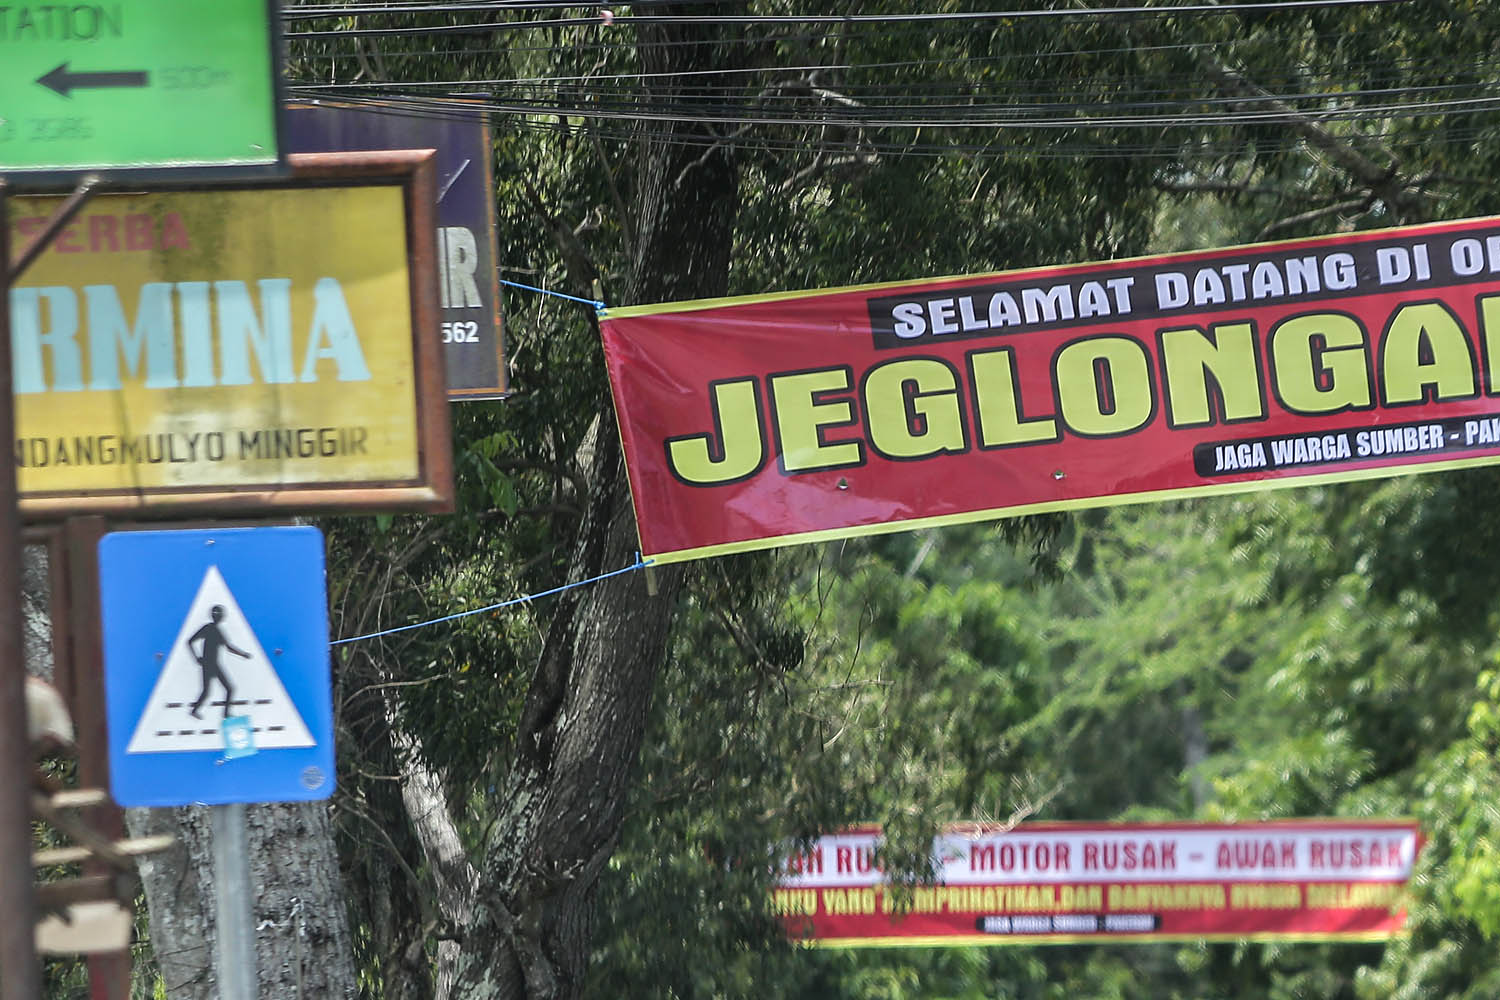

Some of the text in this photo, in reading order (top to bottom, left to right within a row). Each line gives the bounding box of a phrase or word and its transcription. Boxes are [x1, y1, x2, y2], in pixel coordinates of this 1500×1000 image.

[893, 276, 1135, 339] SELAMAT
[1155, 252, 1357, 310] DATANG
[1377, 245, 1430, 285] DI
[441, 321, 480, 343] 562
[239, 426, 368, 461] MINGGIR
[1214, 443, 1267, 471] JAGA
[1273, 438, 1350, 467] WARGA
[1357, 425, 1444, 457] SUMBER
[970, 840, 1070, 873] MOTOR
[1083, 840, 1177, 872] RUSAK
[1217, 839, 1297, 871] AWAK
[1310, 839, 1404, 871] RUSAK
